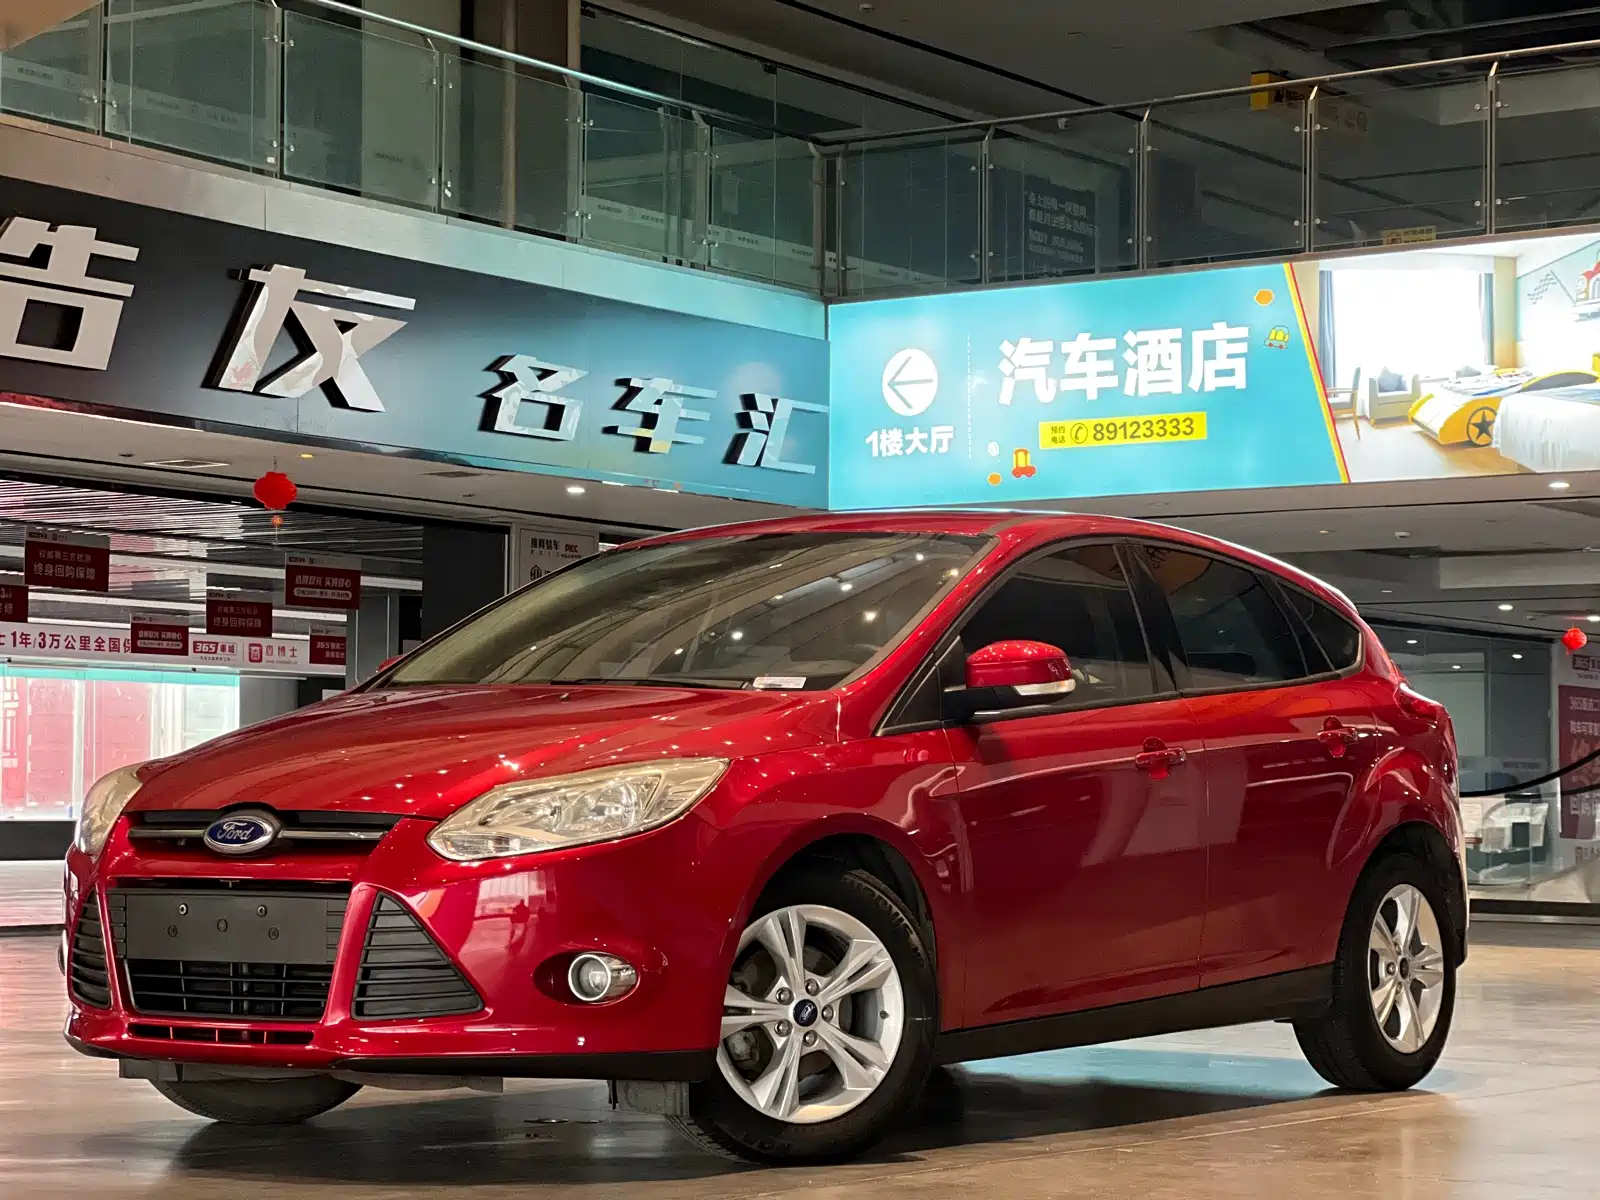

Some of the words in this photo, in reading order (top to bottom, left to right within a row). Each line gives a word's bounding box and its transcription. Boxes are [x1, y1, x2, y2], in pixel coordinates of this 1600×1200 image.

[998, 321, 1250, 406] 汽车酒店
[478, 353, 829, 474] 名车汇
[865, 425, 954, 457] 1楼大厅
[1051, 425, 1066, 434] 预约
[1093, 417, 1195, 441] 89123333
[33, 562, 96, 580] 终身回购保障
[216, 821, 255, 841] Ford
